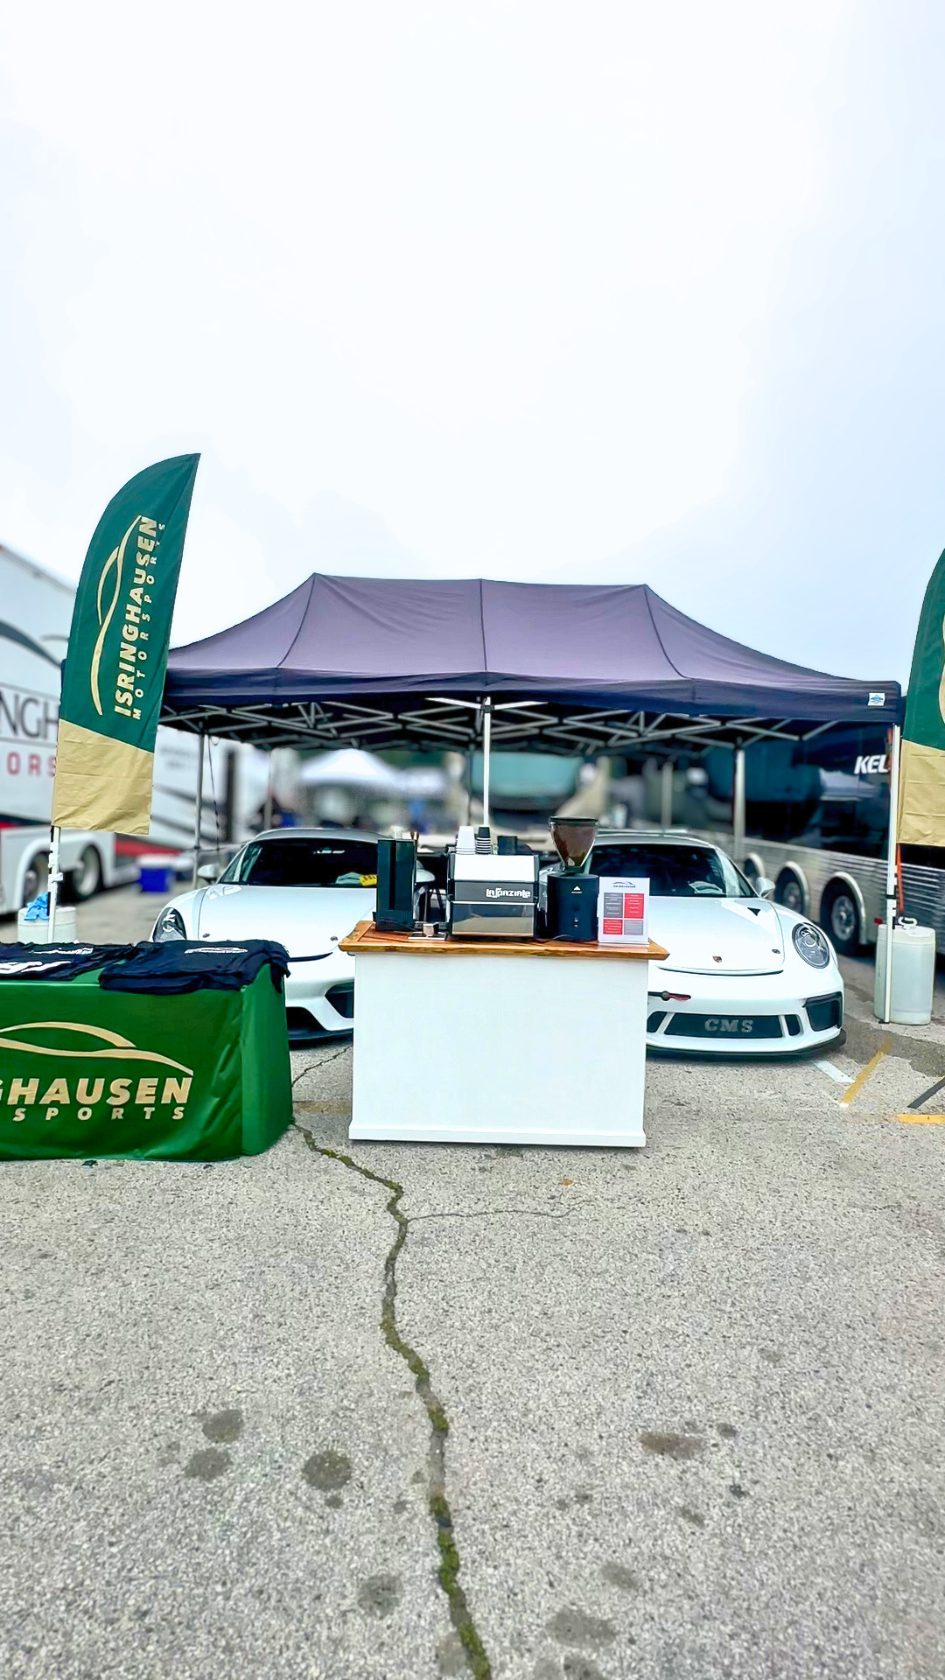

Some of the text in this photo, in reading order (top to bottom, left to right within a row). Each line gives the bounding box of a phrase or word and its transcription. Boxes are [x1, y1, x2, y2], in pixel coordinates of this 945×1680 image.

[114, 516, 157, 717] ISRINGHAUSEN
[854, 755, 889, 774] KEL
[705, 1018, 753, 1033] CMS
[0, 1077, 193, 1106] HAUSEN
[12, 1106, 185, 1122] SPORTS
